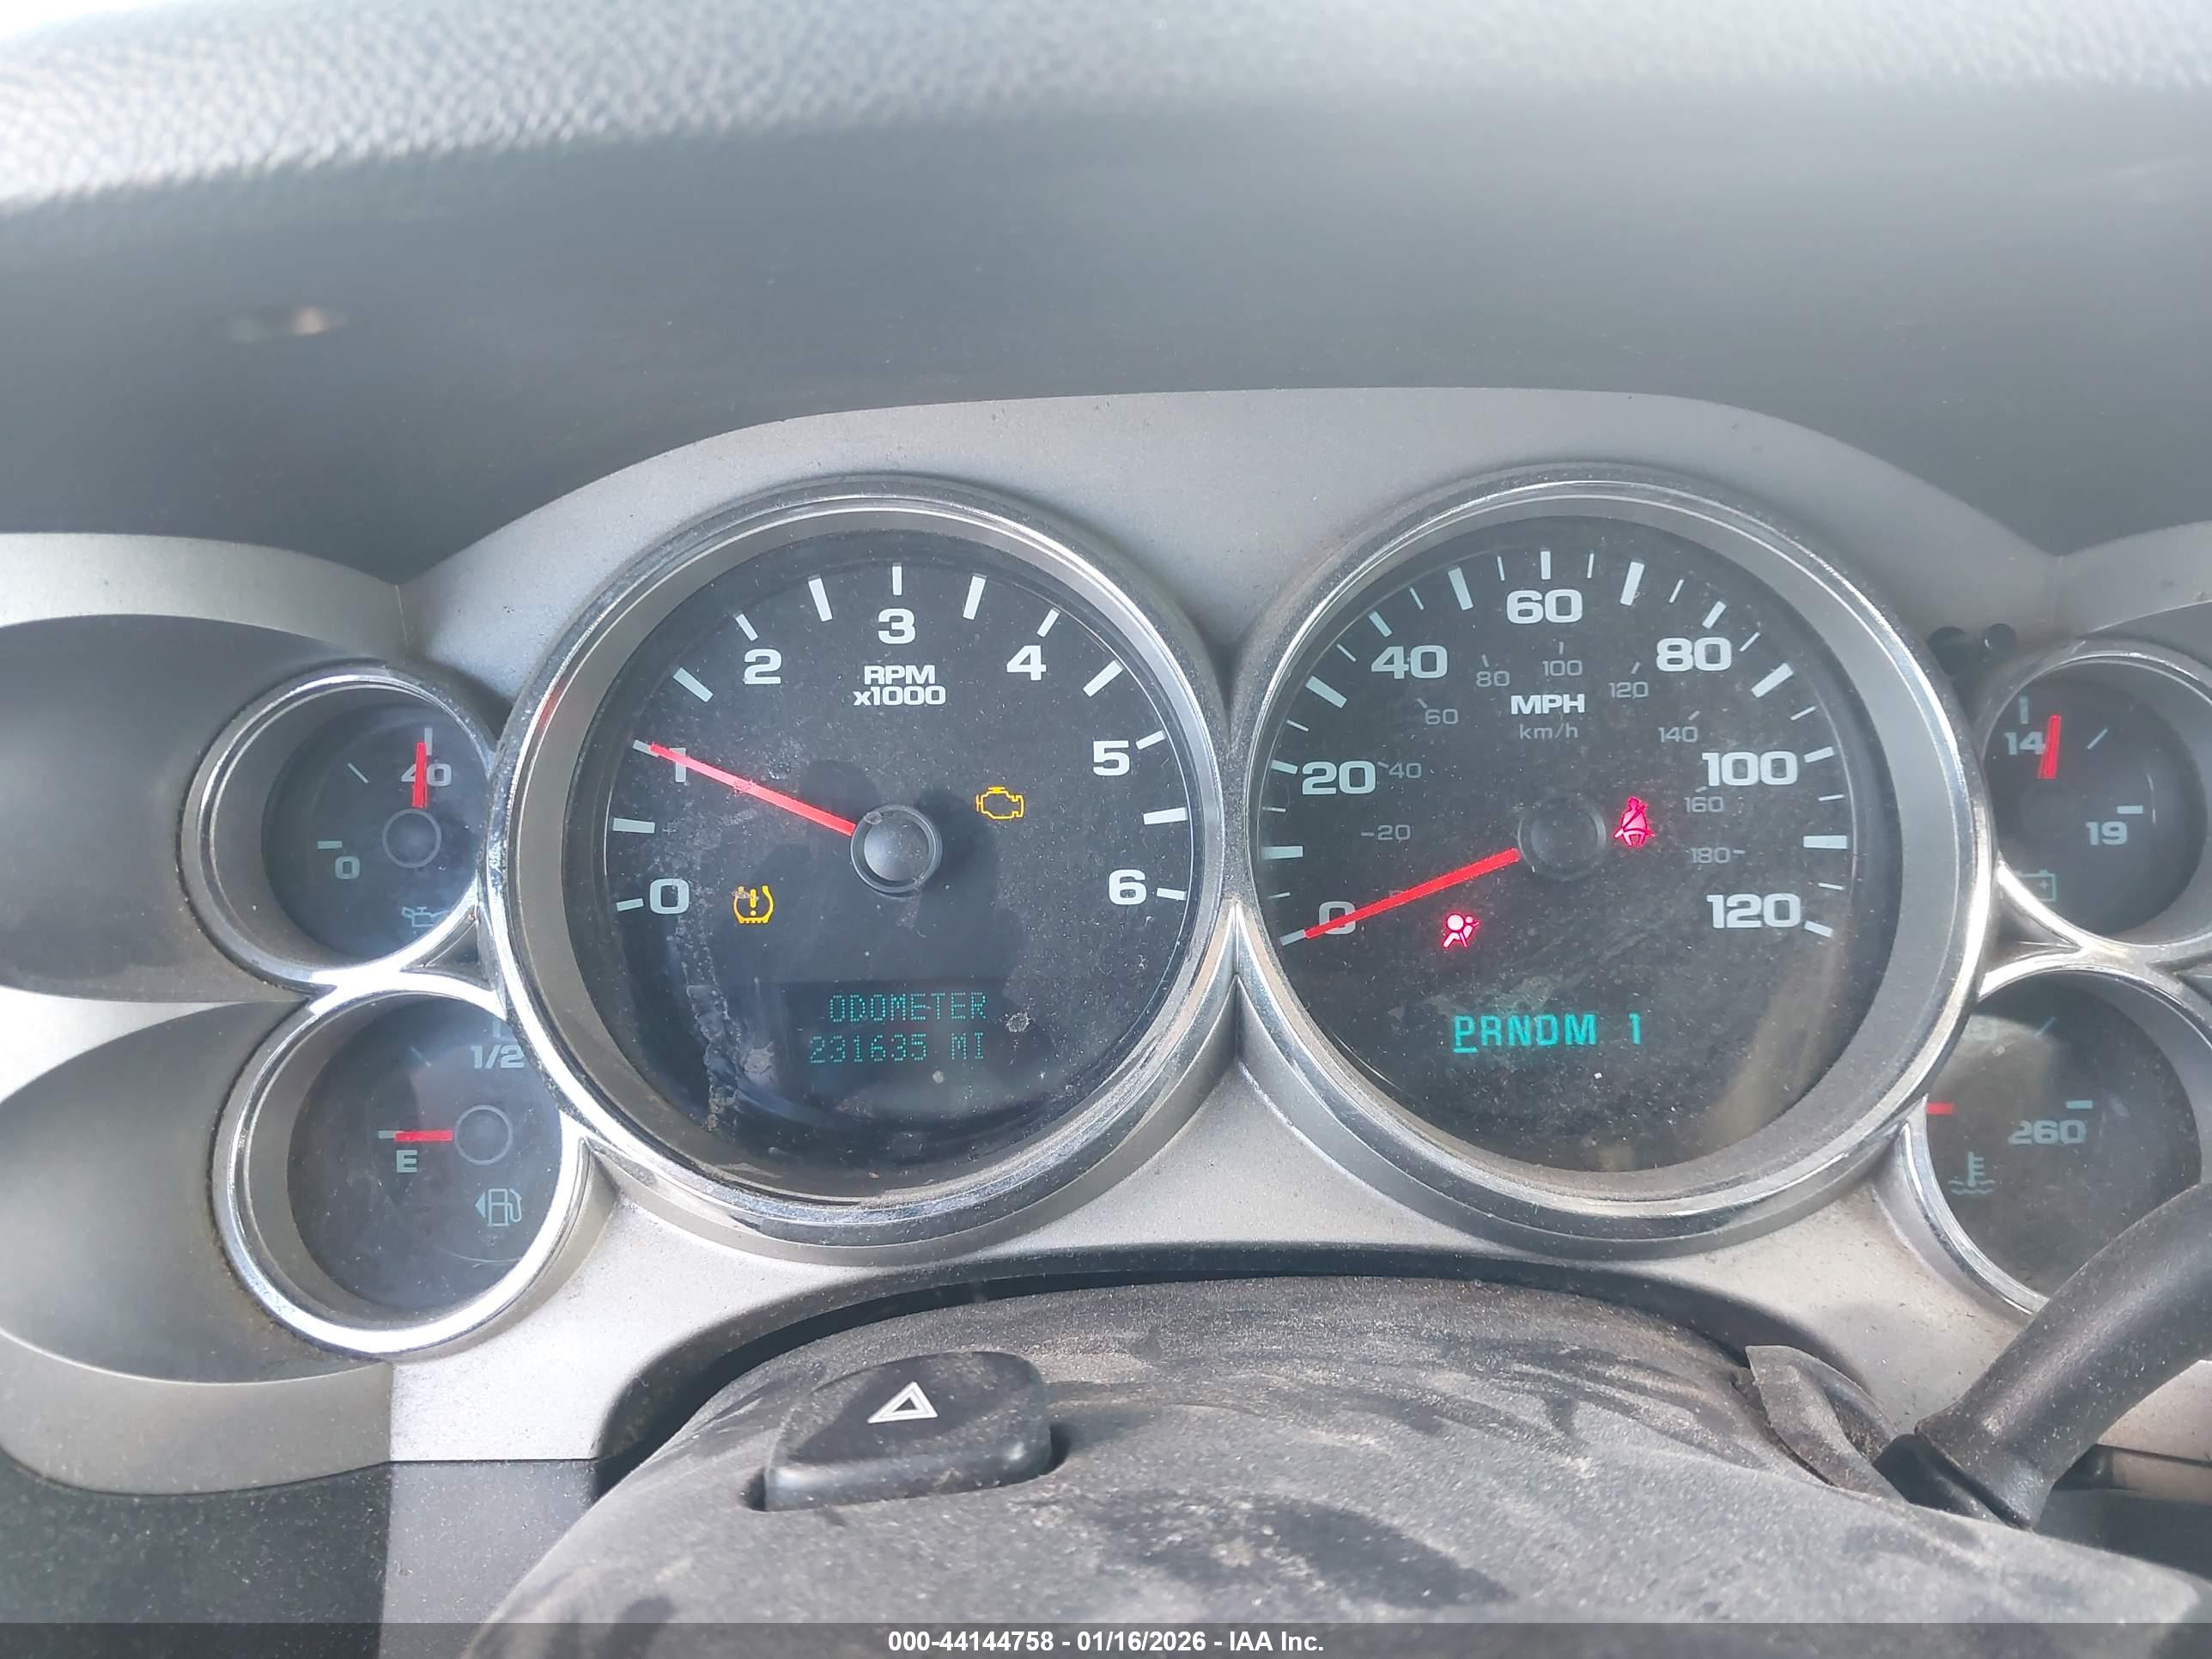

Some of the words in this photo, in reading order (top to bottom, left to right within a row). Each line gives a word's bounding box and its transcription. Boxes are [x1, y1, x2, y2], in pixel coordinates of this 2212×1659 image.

[1507, 590, 1583, 624] 60
[878, 608, 916, 644] 3
[744, 649, 781, 684] 2
[1006, 645, 1047, 681] 4
[1371, 646, 1448, 679] 40
[1656, 637, 1732, 672] 80
[864, 665, 936, 685] RPM
[1476, 671, 1510, 687] 80
[1543, 660, 1583, 677] 100
[853, 686, 945, 706] x1000
[1608, 682, 1649, 698] 120
[1510, 694, 1585, 714] MPH
[1425, 708, 1458, 726] 60
[1519, 723, 1578, 739] km/h
[1658, 726, 1698, 743] 140
[2004, 732, 2045, 756] 14
[1092, 740, 1130, 776] 5
[1702, 750, 1797, 786] 100
[1302, 760, 1376, 795] 20
[1389, 762, 1422, 779] 40
[1684, 796, 1723, 812] 160
[1376, 824, 1411, 842] 20
[2086, 821, 2128, 845] 19
[335, 855, 361, 879] 0
[1691, 847, 1730, 864] 180
[649, 878, 689, 915] 0
[1109, 870, 1146, 904] 6
[1319, 901, 1356, 934] 0
[1706, 893, 1801, 928] 120
[829, 992, 987, 1022] ODOMETER
[1629, 1012, 1641, 1045] 1
[471, 1045, 526, 1069] 1/2
[810, 1033, 927, 1063] 231635
[951, 1032, 983, 1060] MI
[2008, 1120, 2087, 1146] 260
[397, 1150, 418, 1173] E
